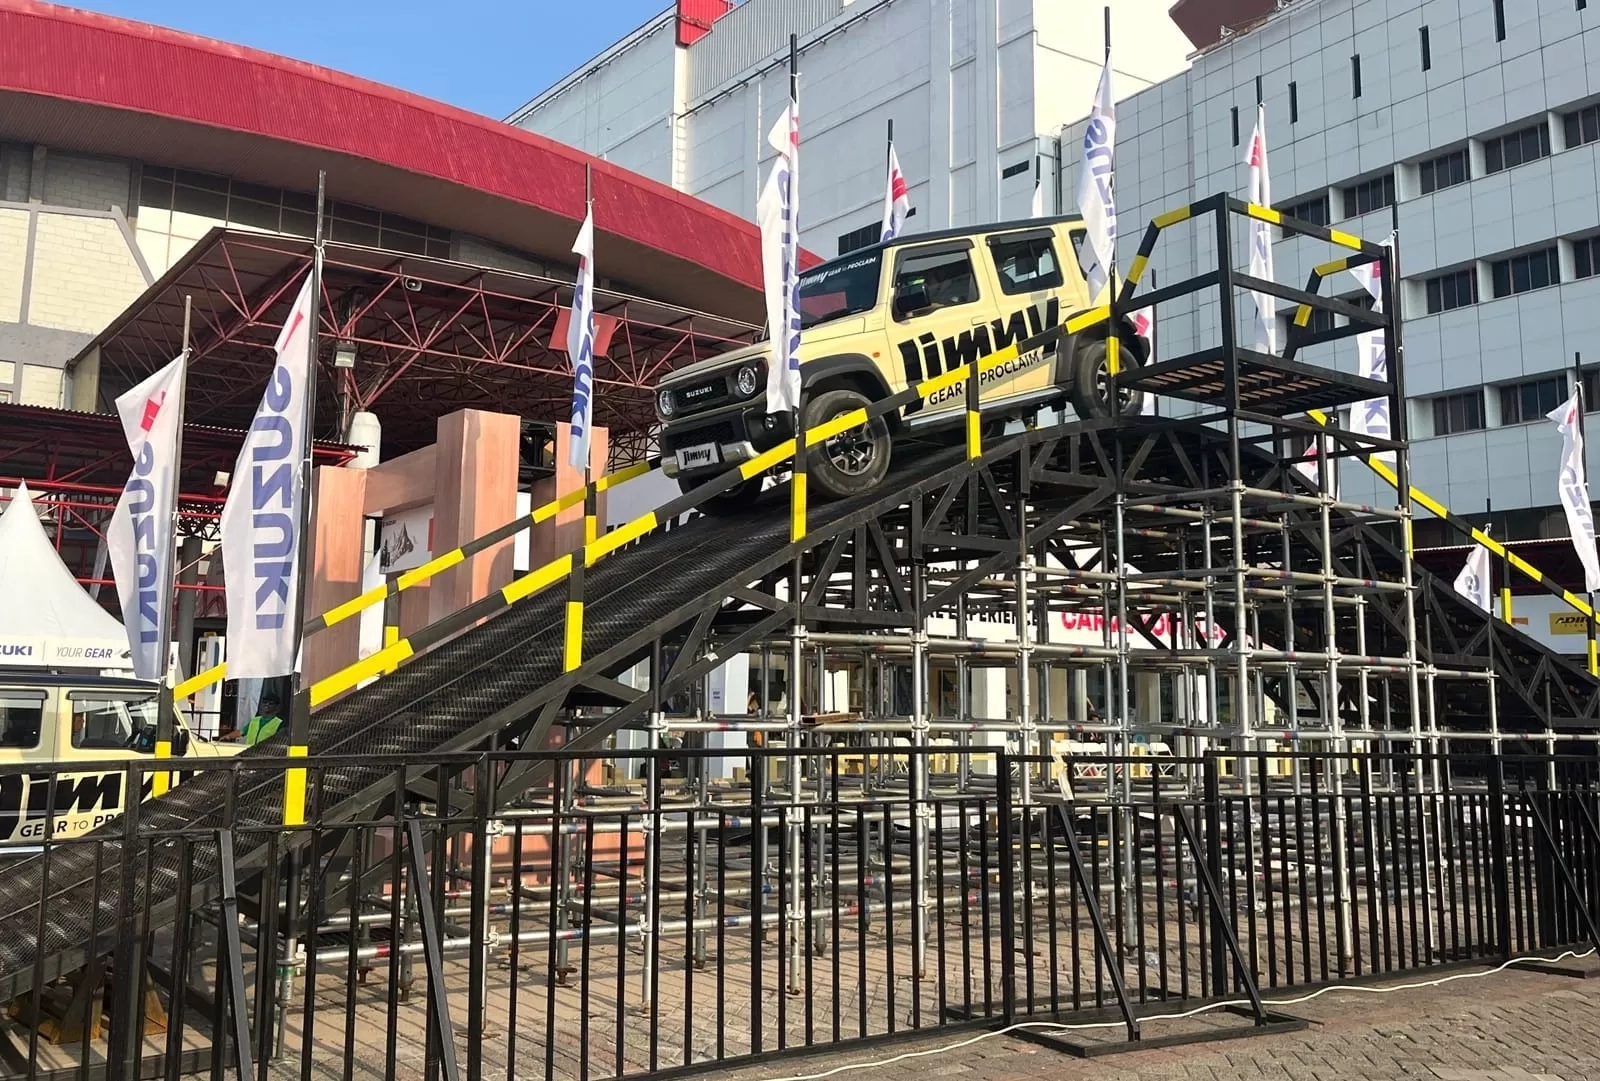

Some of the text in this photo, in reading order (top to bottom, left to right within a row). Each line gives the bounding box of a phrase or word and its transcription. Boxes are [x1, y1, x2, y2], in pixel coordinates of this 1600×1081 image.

[929, 351, 1040, 405] GEAR PROCLAIM
[685, 385, 713, 399] SUZUKI
[56, 646, 113, 659] YOUR GEAR
[73, 819, 89, 832] TO
